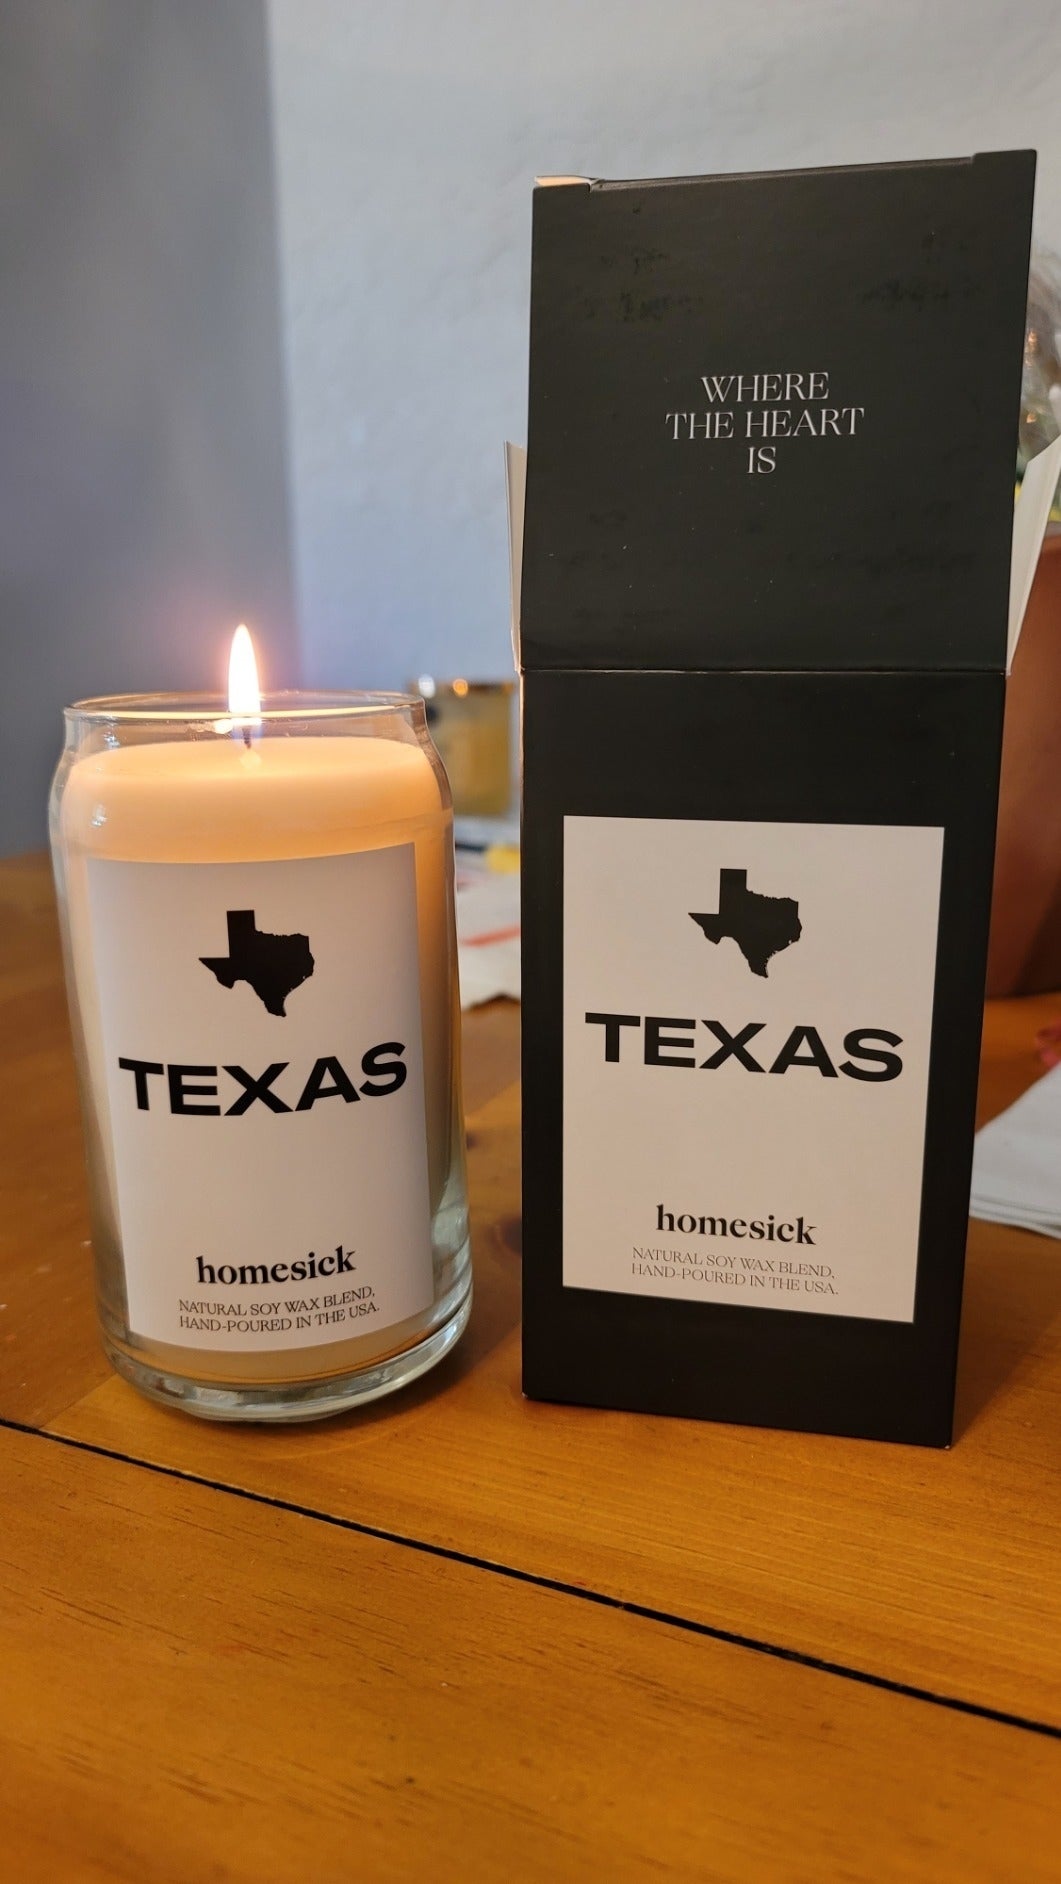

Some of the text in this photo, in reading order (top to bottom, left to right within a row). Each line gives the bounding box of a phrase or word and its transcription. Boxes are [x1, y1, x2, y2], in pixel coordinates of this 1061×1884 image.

[701, 372, 829, 403] WHERE
[665, 407, 865, 440] THE HEART
[747, 446, 776, 474] IS
[585, 1012, 903, 1083] TEXAS
[118, 1041, 408, 1116] TEXAS
[655, 1204, 817, 1245] homesick
[196, 1245, 356, 1285] homesick
[631, 1263, 839, 1295] HAND-POURED IN THE USA.
[632, 1247, 835, 1279] NATURAL SOY WAX BLEND,
[179, 1285, 375, 1316] NATURAL SOY WAX BLEND,
[179, 1301, 380, 1332] HAND-POURED IN THE USA.
